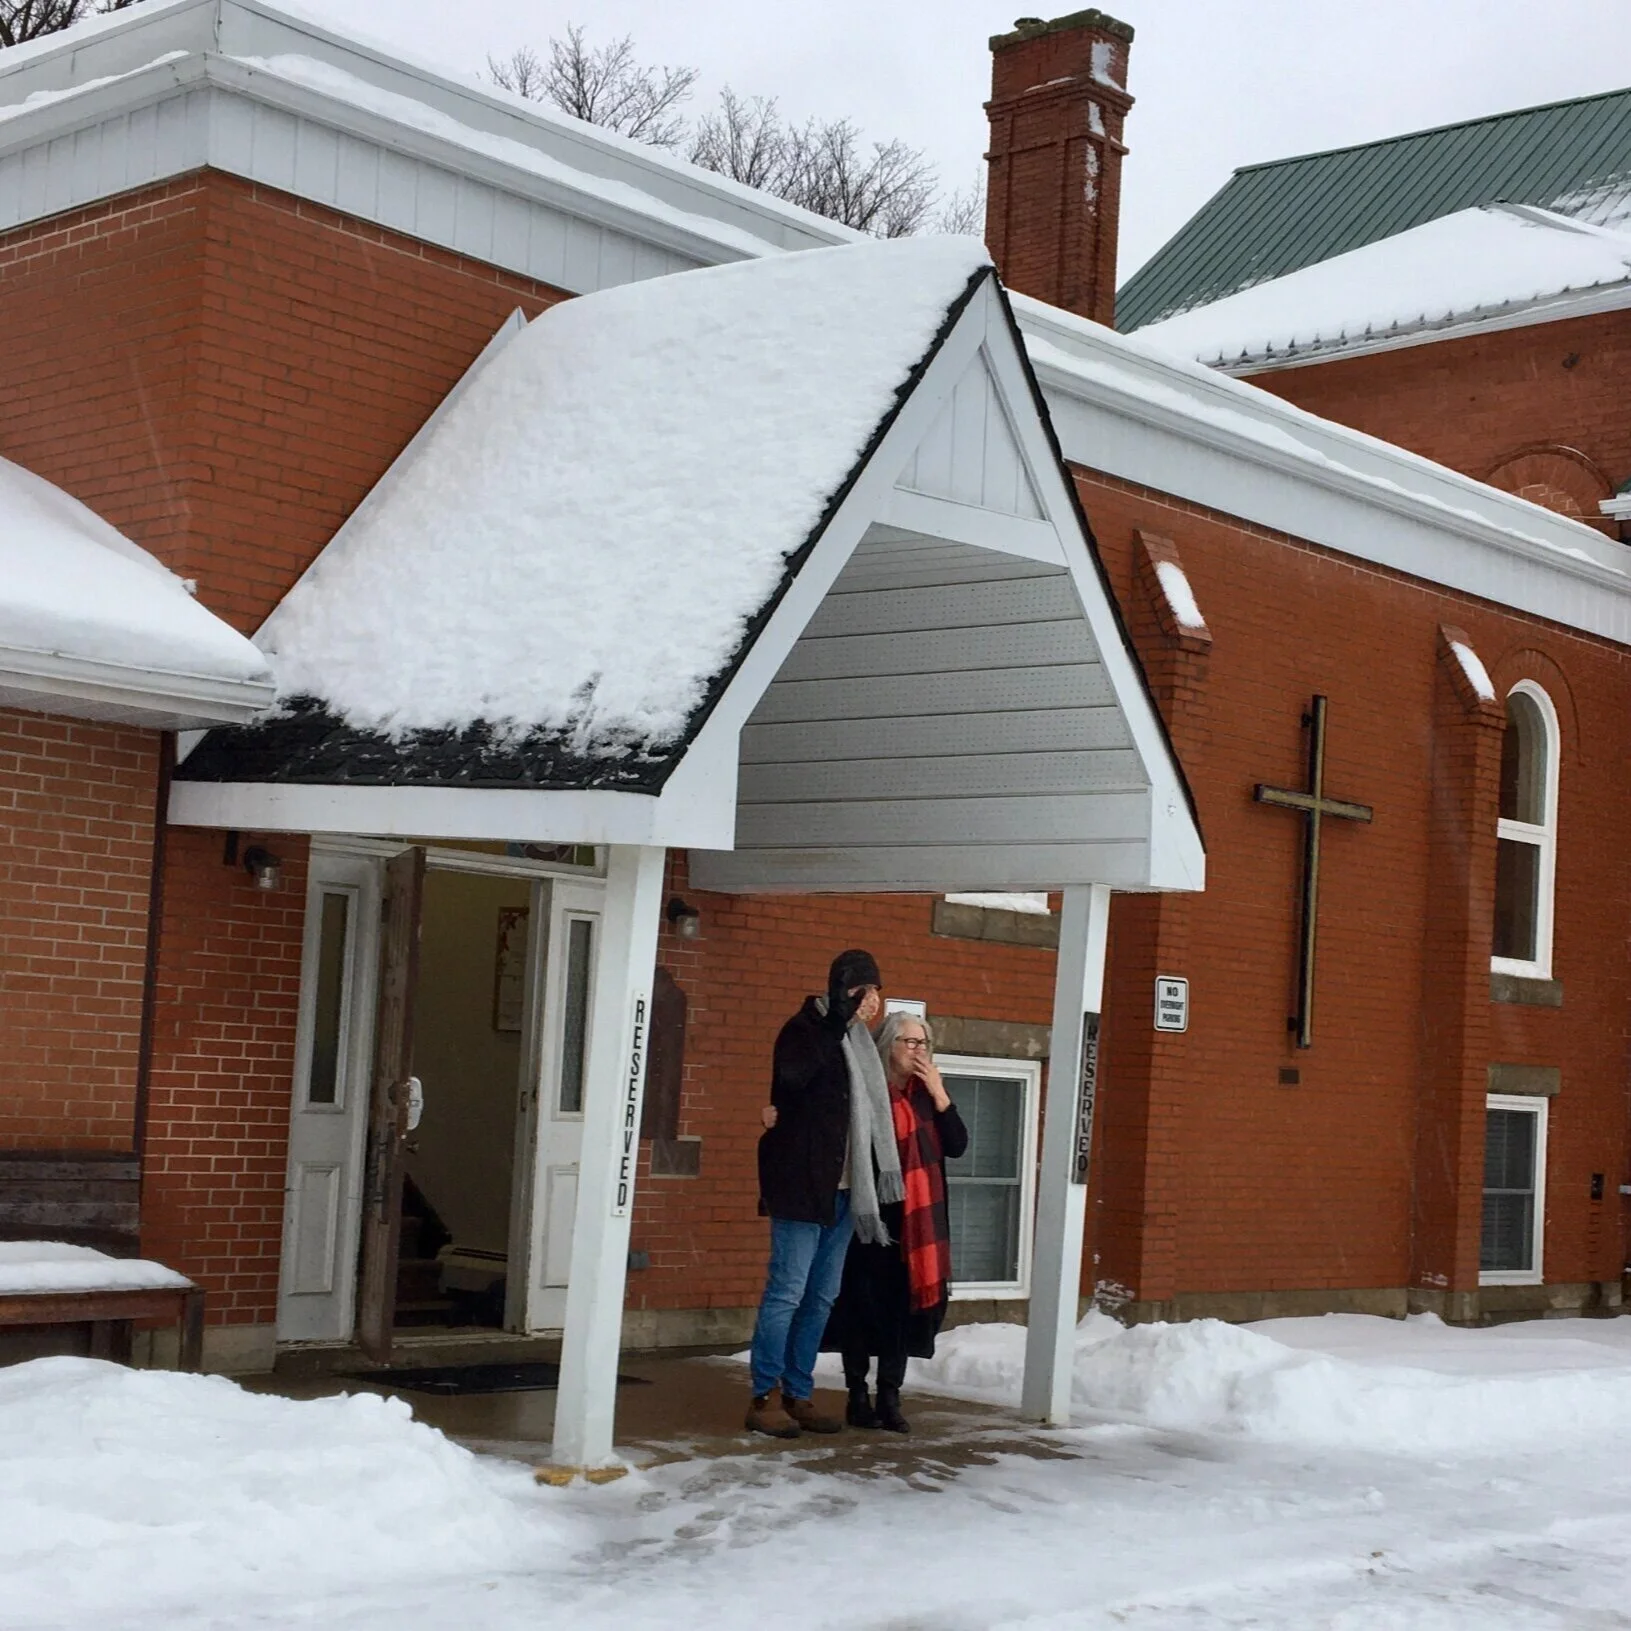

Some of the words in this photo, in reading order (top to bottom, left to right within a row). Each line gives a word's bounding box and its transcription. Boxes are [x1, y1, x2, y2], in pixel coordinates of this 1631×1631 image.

[1167, 986, 1179, 997] NO
[617, 999, 645, 1206] RESERVED
[1077, 1023, 1098, 1173] RESERVED
